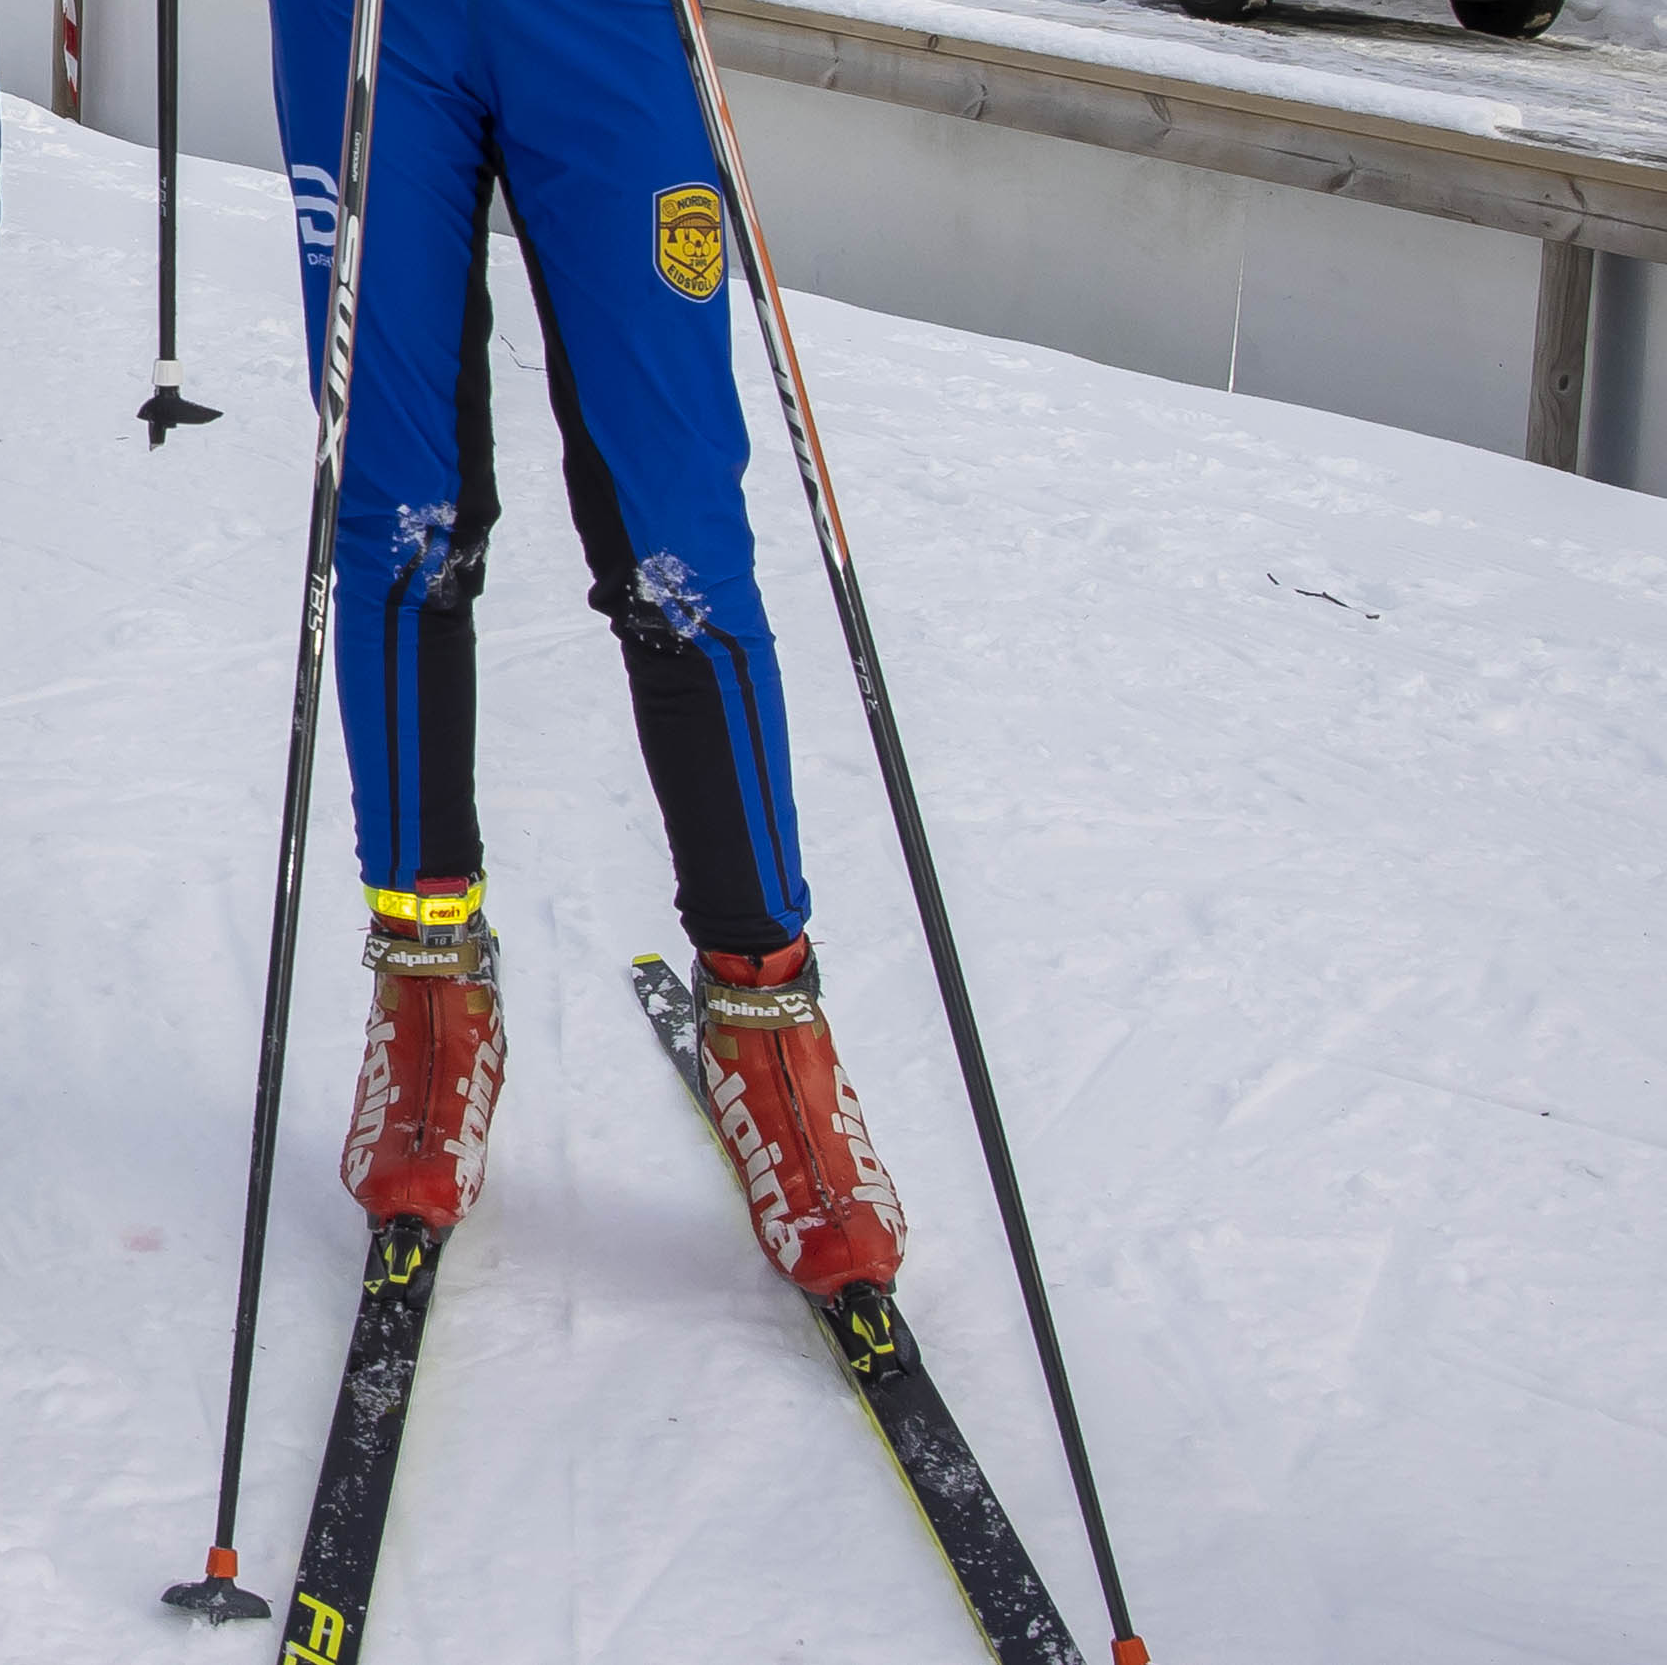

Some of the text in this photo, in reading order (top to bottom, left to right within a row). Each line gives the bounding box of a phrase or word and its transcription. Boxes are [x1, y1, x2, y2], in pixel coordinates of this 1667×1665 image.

[386, 950, 458, 965] alpina
[708, 997, 781, 1018] alpina
[831, 1064, 907, 1257] alpin
